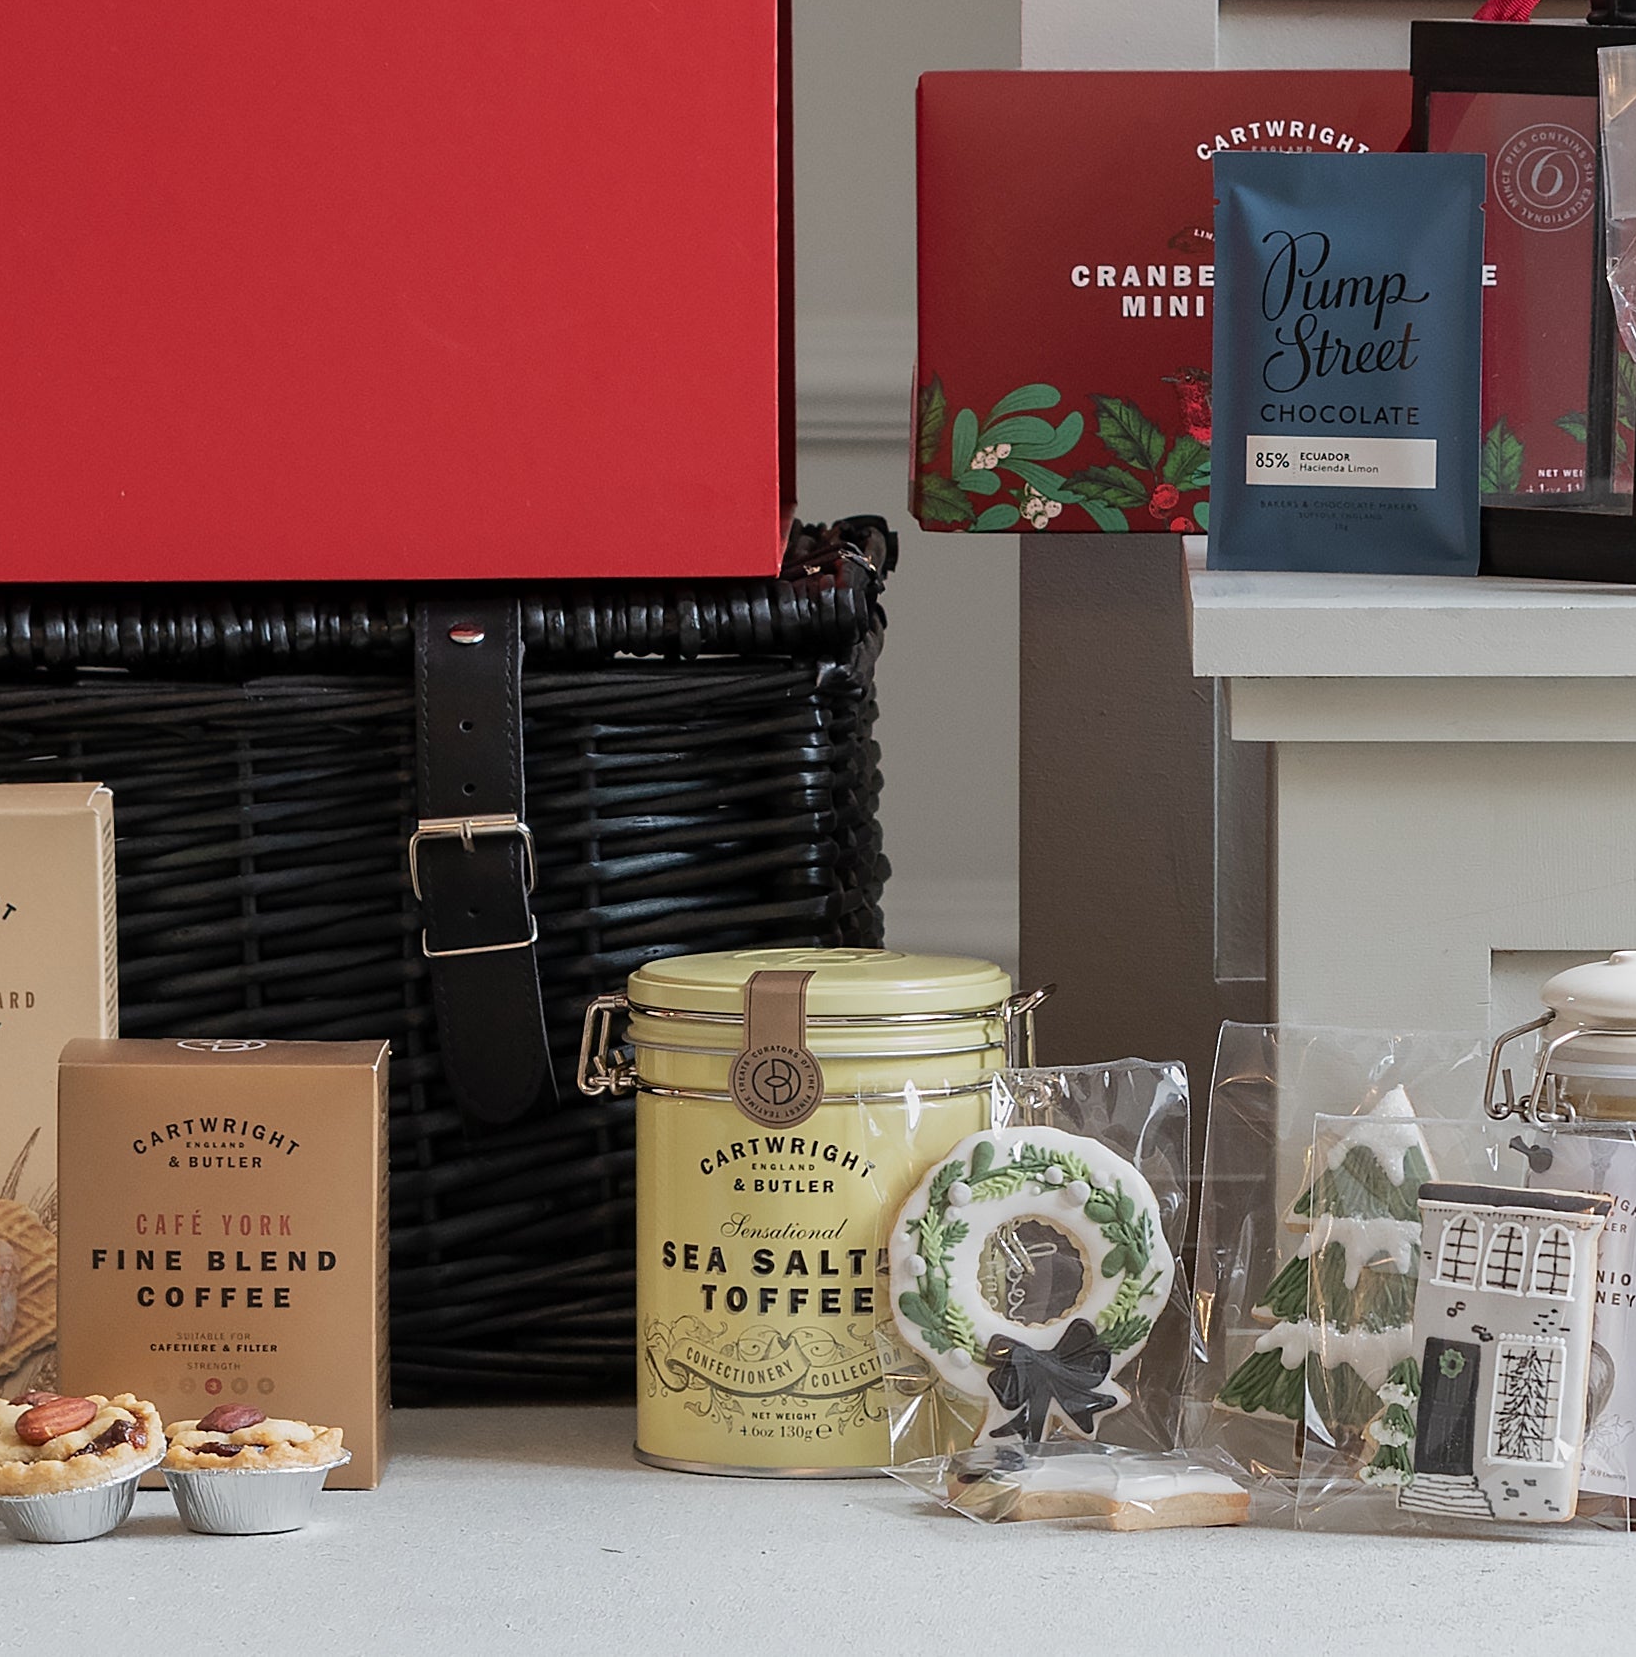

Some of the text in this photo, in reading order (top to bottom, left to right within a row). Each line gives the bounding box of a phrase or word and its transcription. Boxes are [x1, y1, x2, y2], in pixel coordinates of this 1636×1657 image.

[1502, 132, 1594, 223] CONTAINS SIX EXCEPTIONAL MINCE PIES
[1531, 150, 1570, 197] 6
[1071, 265, 1215, 287] CRANBE
[1262, 230, 1430, 331] Pump
[1122, 295, 1204, 317] MINI
[1263, 313, 1420, 393] Street
[1261, 403, 1420, 426] CHOCOLATE
[1256, 453, 1289, 468] 85%
[1300, 452, 1350, 462] ECUADOR
[1300, 464, 1379, 473] Hacienda Limon
[1538, 469, 1559, 477] NET
[752, 1045, 800, 1058] CURATORS
[739, 1061, 750, 1092] TREATS
[744, 1096, 780, 1118] TEATIME
[785, 1094, 811, 1117] FINEST
[132, 1117, 301, 1157] CARTWRIGHT
[185, 1141, 245, 1149] ENGLAND
[168, 1156, 263, 1169] & BUTLER
[700, 1136, 876, 1178] CARTWRIGHT
[752, 1163, 815, 1171] ENGLAND
[733, 1178, 834, 1193] & BUTLER
[136, 1209, 293, 1236] CAFÉ YORK
[720, 1212, 848, 1240] Sensational
[92, 1249, 338, 1272] FINE BLEND
[662, 1240, 728, 1274] SEA
[137, 1286, 292, 1308] COFFEE
[701, 1283, 874, 1316] TOFFEE
[150, 1344, 278, 1352] CAFETIERE & FILTER
[187, 1362, 241, 1370] STRENGTH
[686, 1346, 903, 1389] CONFECTIONERY COLLECTION
[752, 1411, 817, 1421] NET WEIGHT
[779, 1423, 813, 1442] 130g
